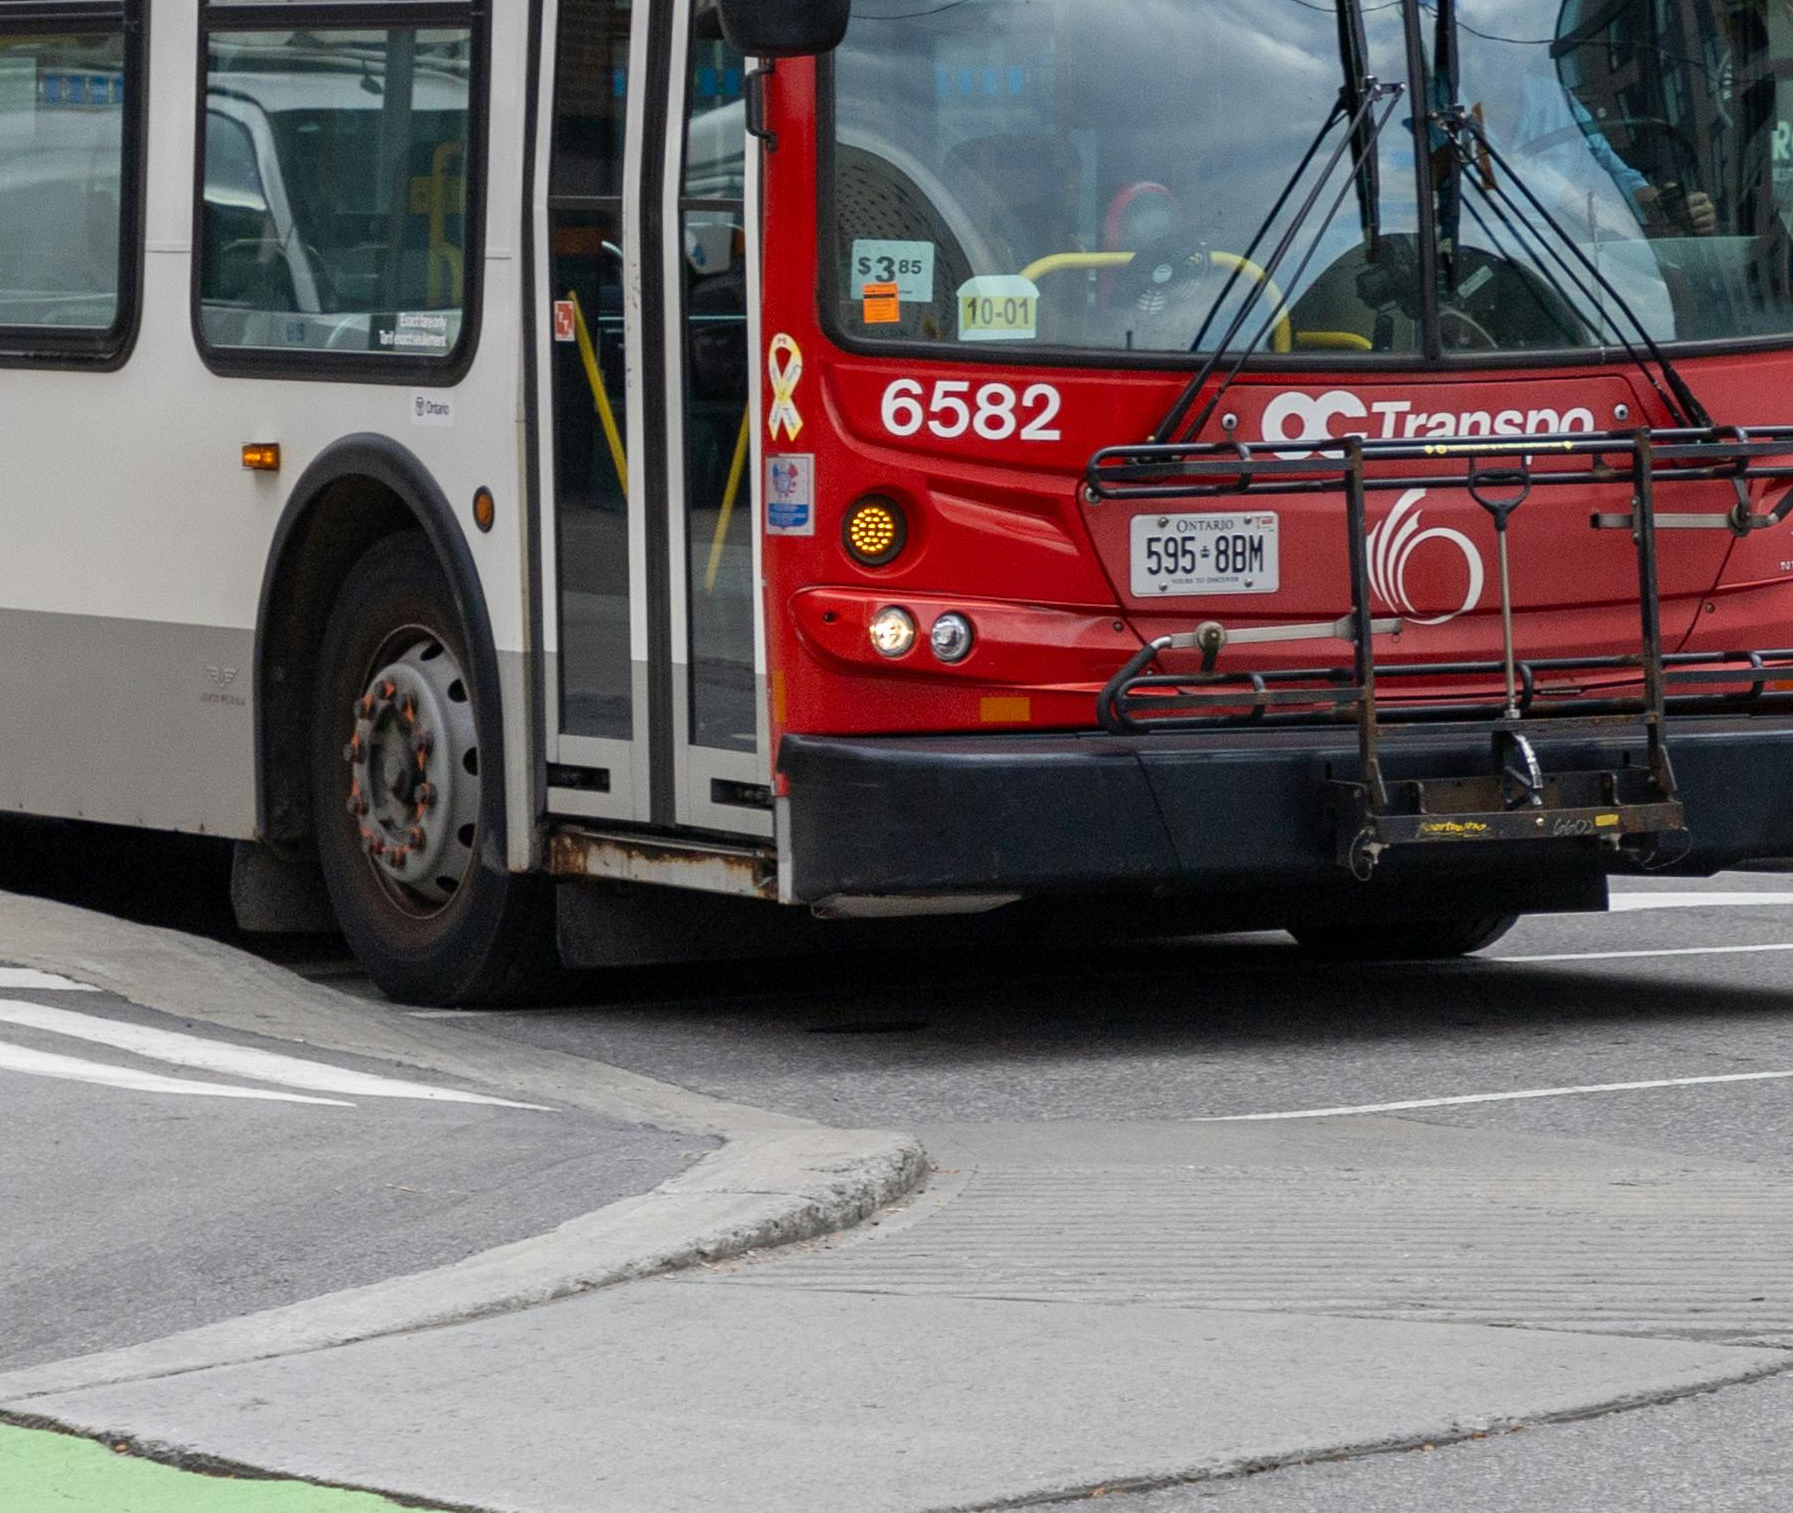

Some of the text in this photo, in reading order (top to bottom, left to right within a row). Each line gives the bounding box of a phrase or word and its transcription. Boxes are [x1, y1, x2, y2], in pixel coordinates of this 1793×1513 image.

[967, 298, 1029, 325] 10-01
[880, 378, 1062, 442] 6582
[1147, 534, 1264, 576] 595 8BM
